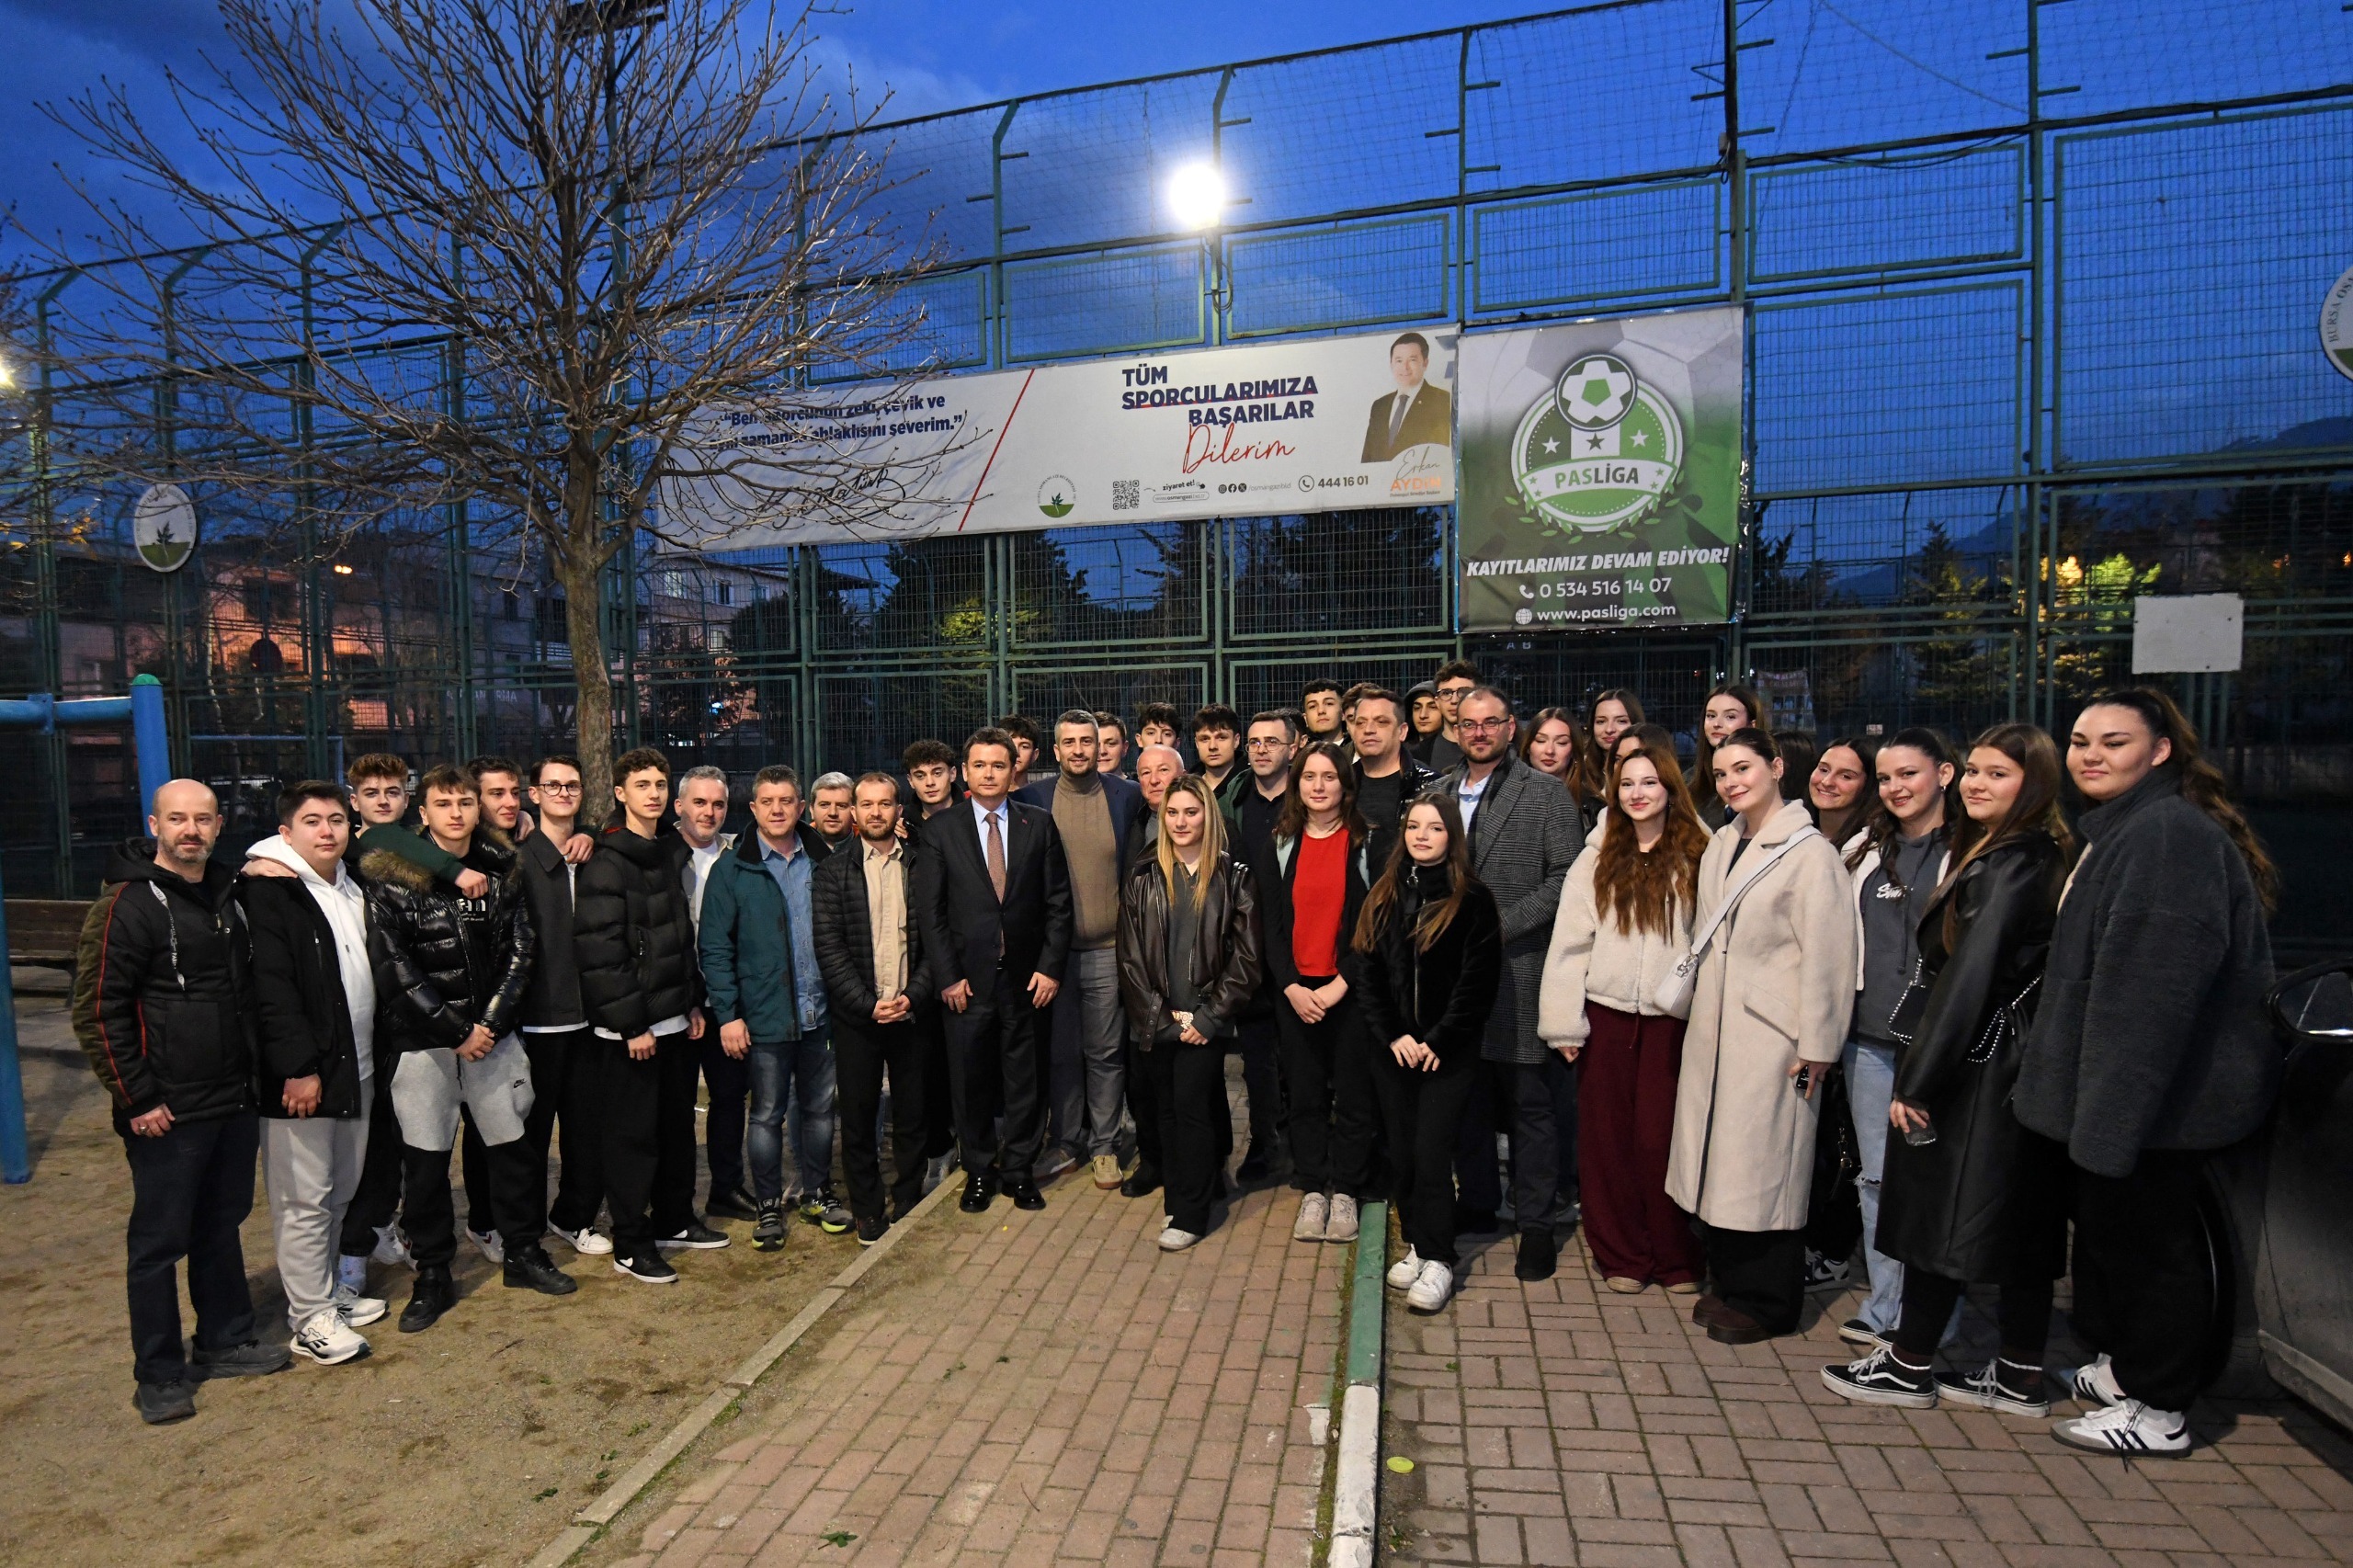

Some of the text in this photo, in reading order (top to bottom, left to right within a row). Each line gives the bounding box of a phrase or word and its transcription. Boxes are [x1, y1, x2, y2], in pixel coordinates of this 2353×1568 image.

[1121, 363, 1167, 387] TÜM
[883, 394, 924, 415] çevik
[927, 394, 946, 409] ve
[1121, 375, 1318, 410] SPORCULARIMIZA
[1188, 400, 1314, 428] BAŞARILAR
[1182, 422, 1296, 473] Dilerim
[1163, 479, 1195, 492] ziyaret et!
[1317, 475, 1369, 488] 444 16 01
[1555, 462, 1639, 489] PASLİGA
[1466, 545, 1730, 577] KAYITLARIMIZ DEVAM EDİYOR!
[1540, 577, 1672, 598] 0 534 516 14 07
[1537, 604, 1676, 622] www.pasliga.com
